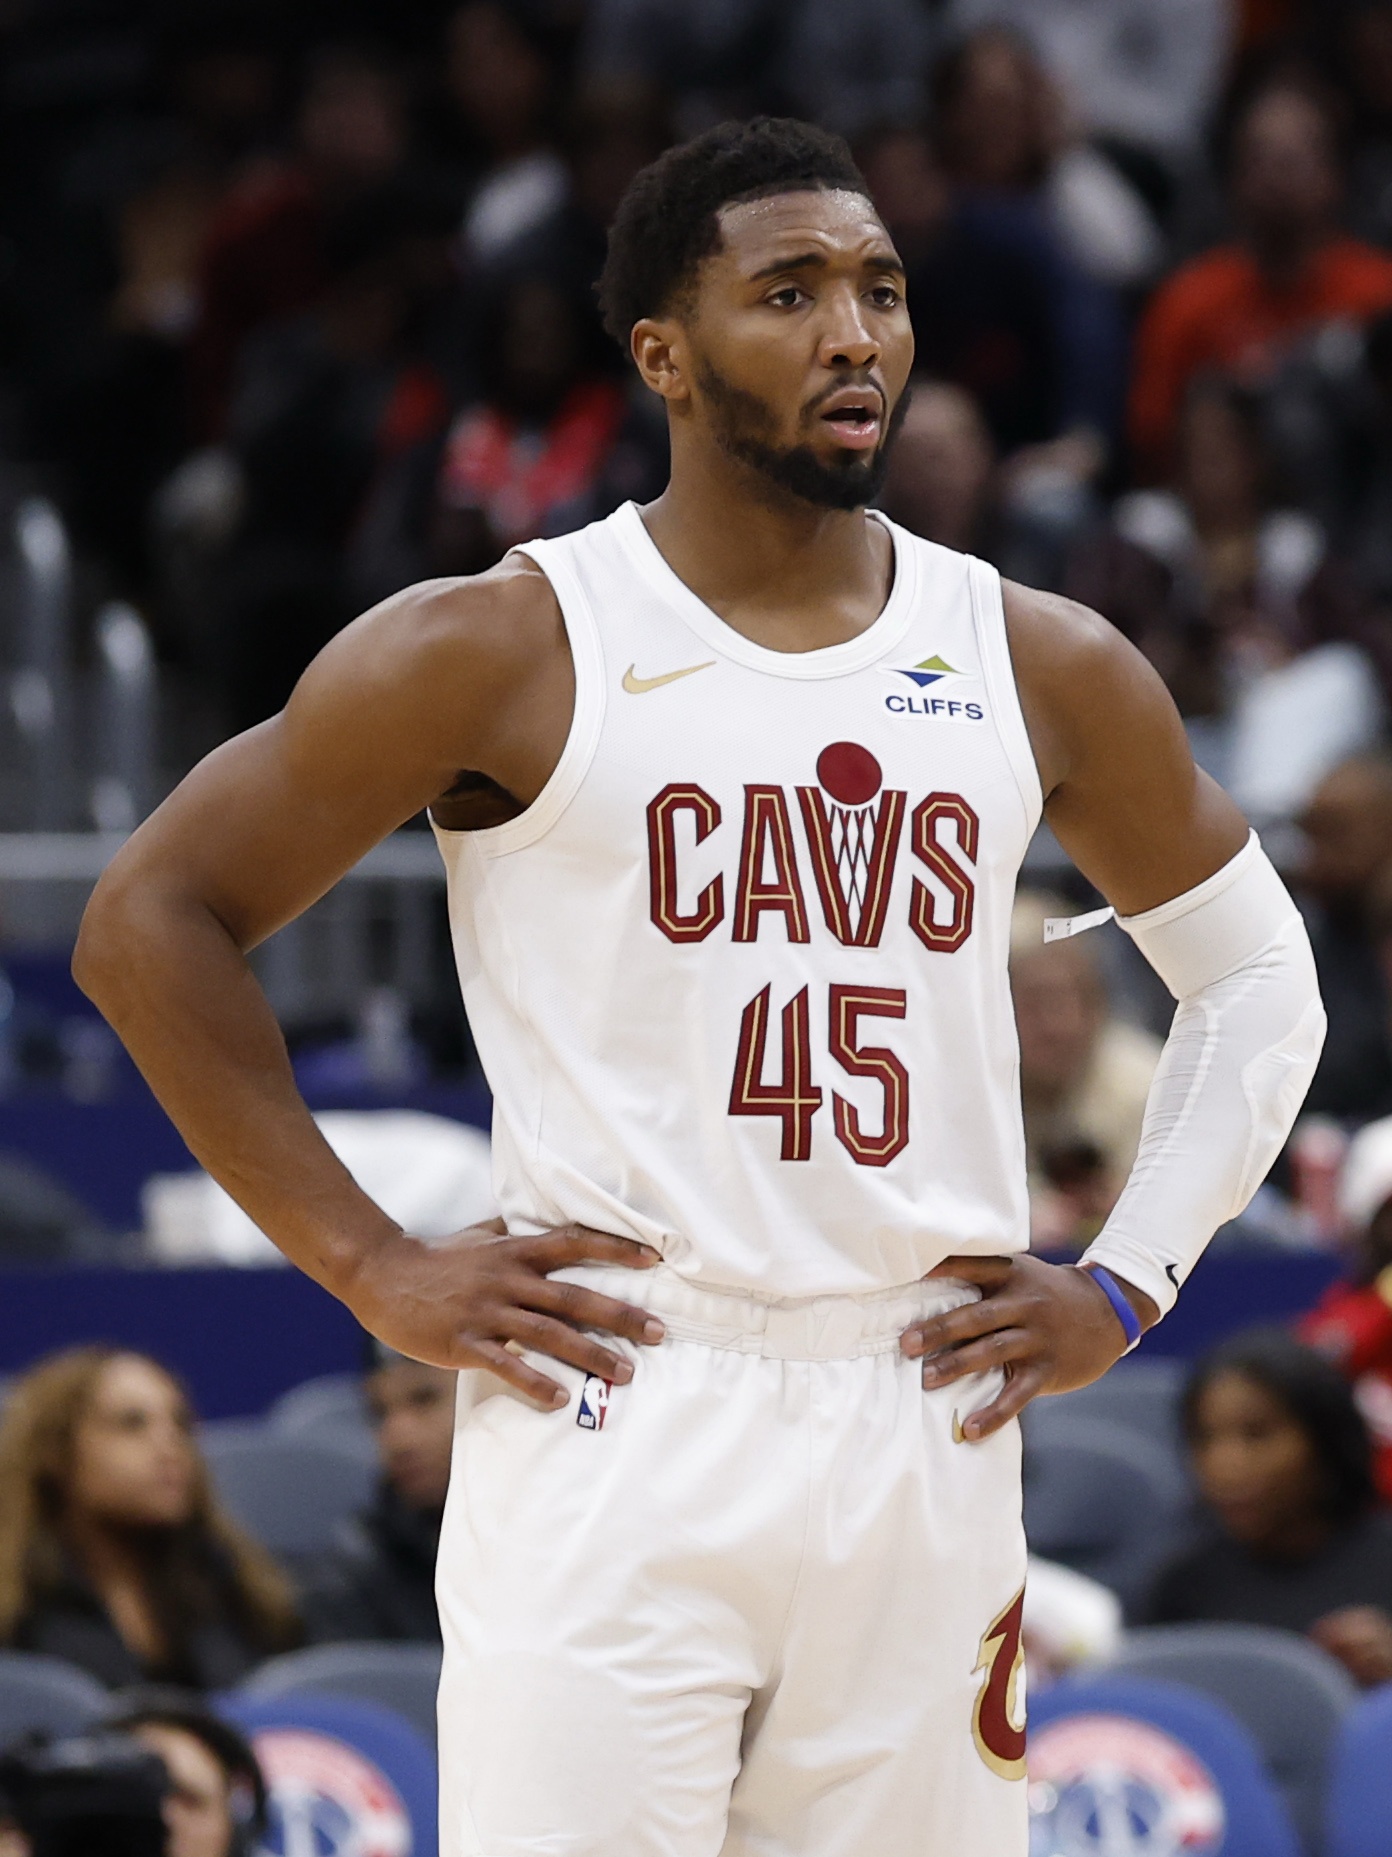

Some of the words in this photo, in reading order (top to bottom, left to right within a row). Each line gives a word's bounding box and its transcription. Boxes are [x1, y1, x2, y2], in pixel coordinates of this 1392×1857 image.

[885, 695, 984, 720] CLIFFS
[646, 783, 980, 954] CAVS
[728, 981, 910, 1168] 45
